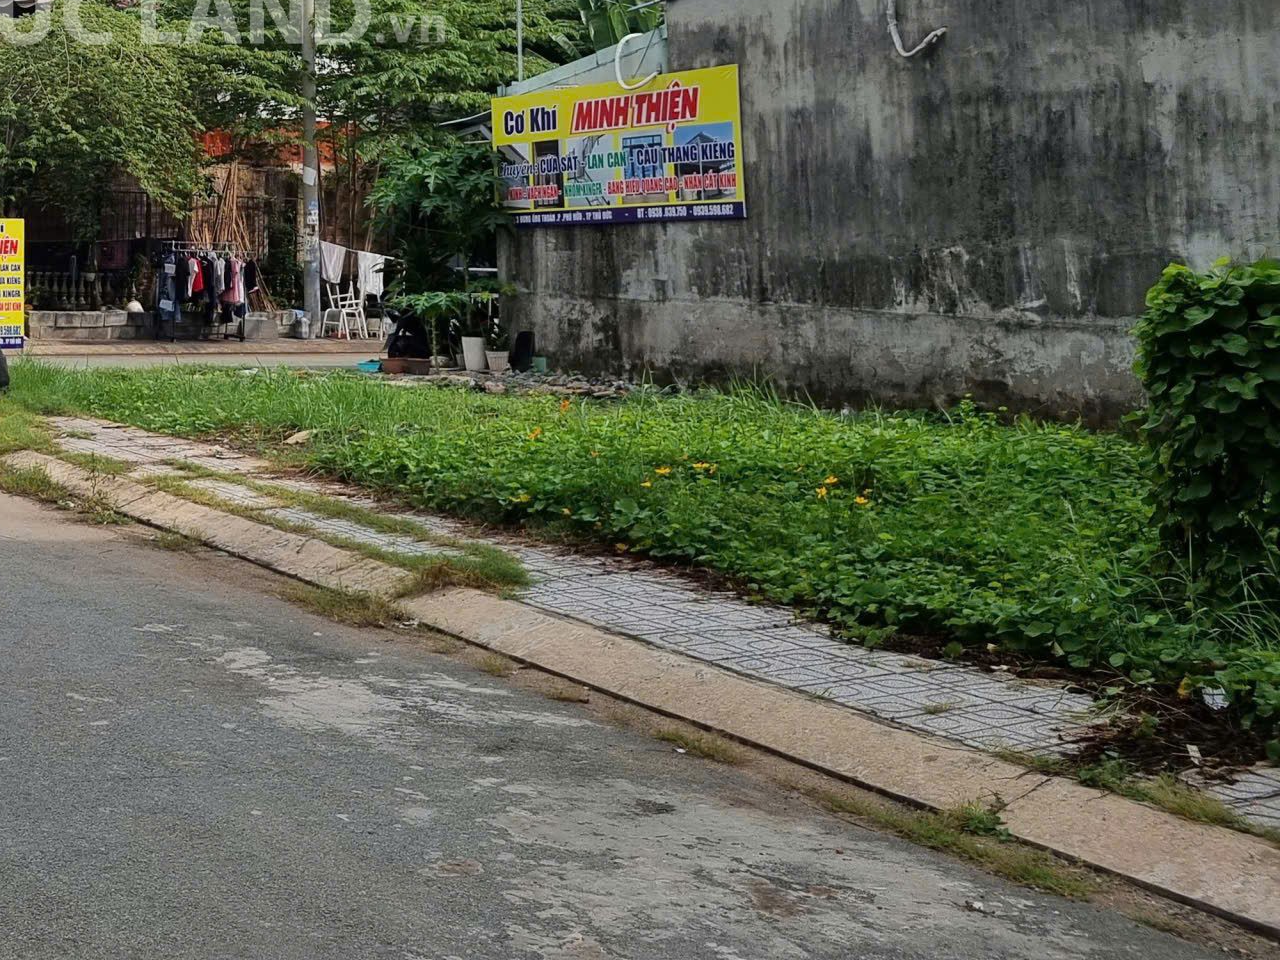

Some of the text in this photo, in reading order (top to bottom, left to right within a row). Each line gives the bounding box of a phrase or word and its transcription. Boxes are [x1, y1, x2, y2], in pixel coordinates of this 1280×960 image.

[504, 80, 699, 136] Cơ Khí MINH THIỆN
[587, 153, 604, 170] LAN
[607, 151, 626, 169] CAN
[661, 143, 698, 163] THANG
